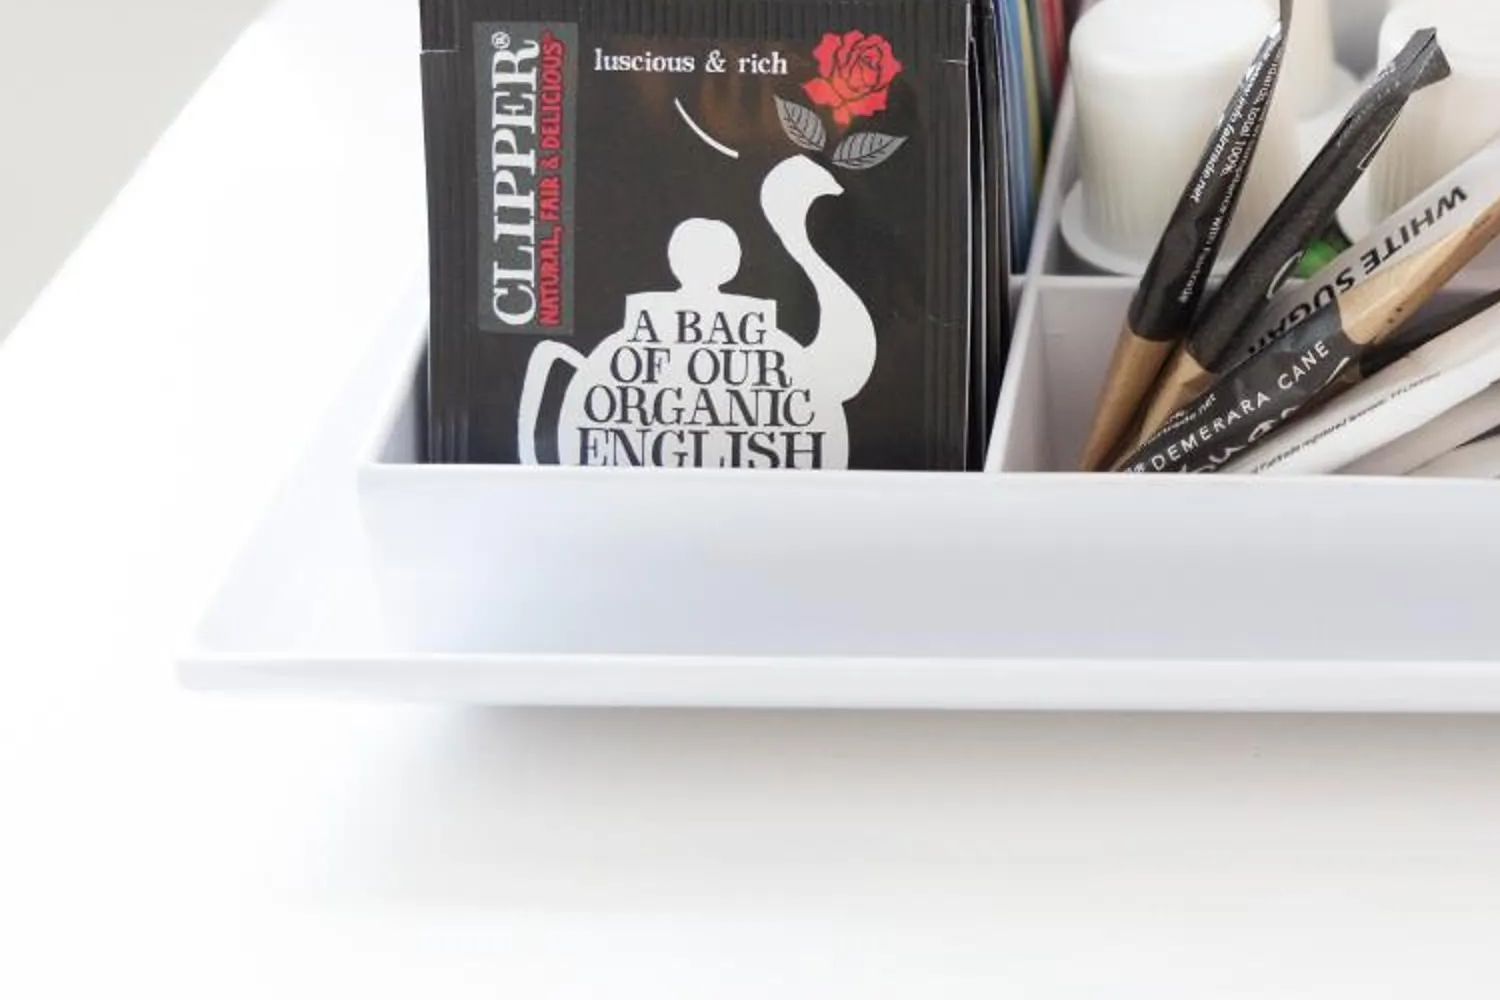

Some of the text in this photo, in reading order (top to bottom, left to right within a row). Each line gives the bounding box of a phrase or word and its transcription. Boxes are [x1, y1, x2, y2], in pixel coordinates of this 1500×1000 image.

[595, 48, 787, 74] luscious & rich
[1238, 104, 1261, 139] total
[540, 155, 560, 168] &
[539, 176, 561, 220] FAIR
[1360, 186, 1468, 274] WHITE
[538, 224, 562, 324] NATURAL,
[628, 310, 766, 344] A BAG
[610, 348, 792, 389] OF OUR
[584, 384, 814, 426] ORGANIC
[1148, 386, 1272, 472] DEMERARA
[1275, 339, 1330, 392] CANE
[578, 428, 825, 467] ENGLISH
